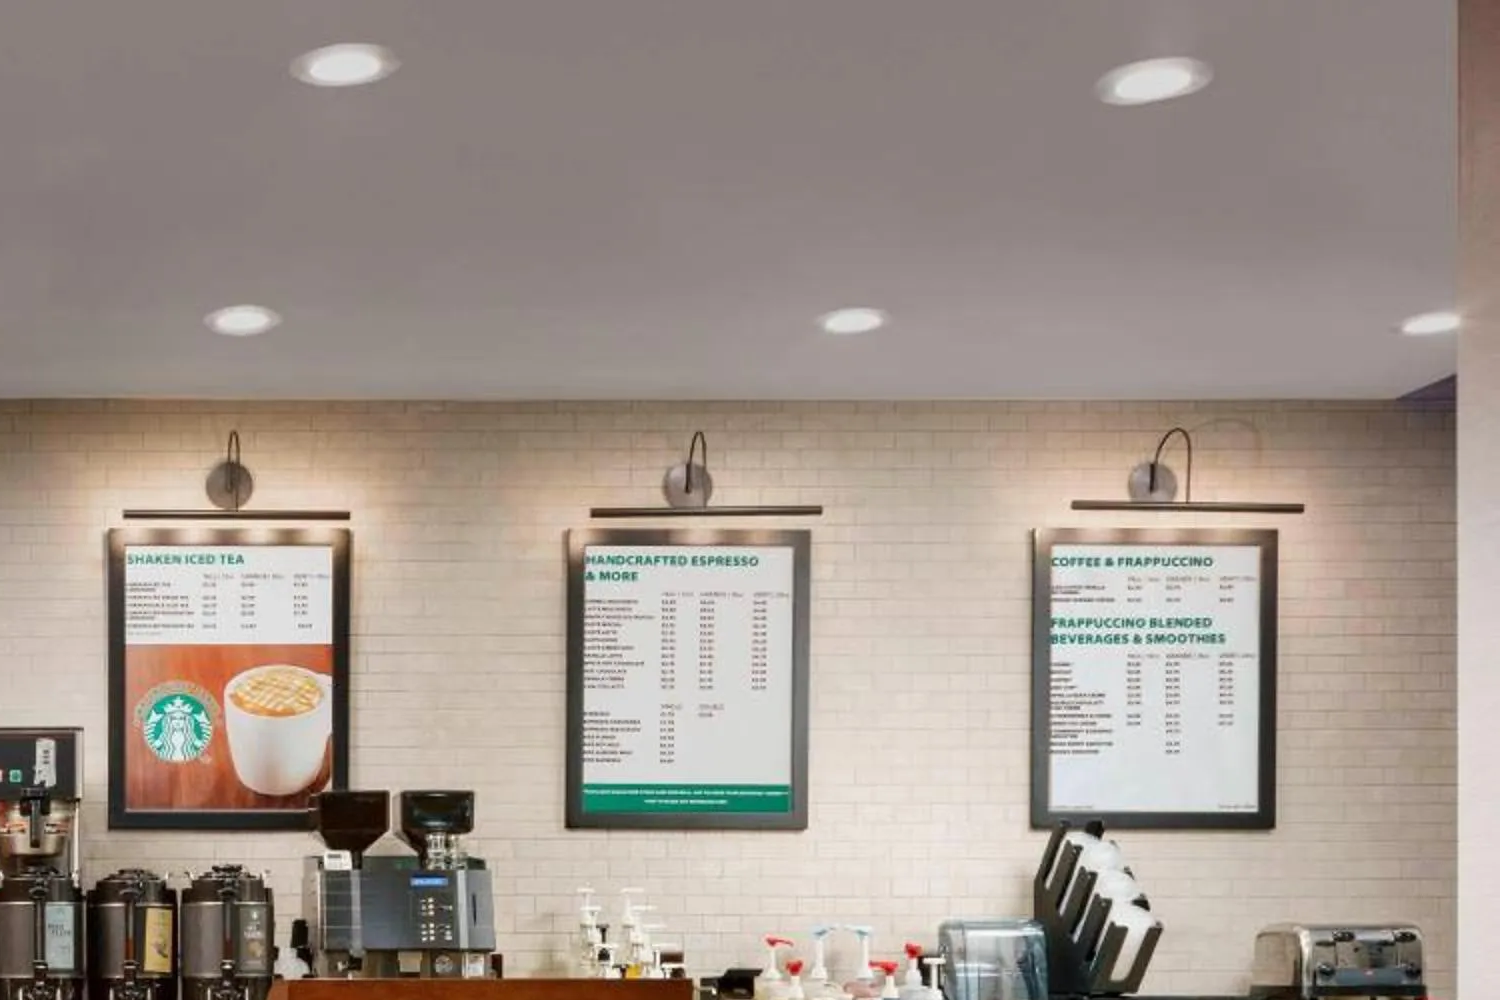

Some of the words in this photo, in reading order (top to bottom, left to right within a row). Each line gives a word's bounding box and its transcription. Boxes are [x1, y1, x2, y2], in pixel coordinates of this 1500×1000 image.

[127, 554, 182, 565] SHAKEN
[184, 554, 215, 565] ICED
[220, 553, 245, 565] TEA
[585, 555, 688, 566] HANDCRAFTED
[691, 556, 759, 567] ESPRESSO
[1051, 557, 1100, 567] COFFEE
[1104, 557, 1114, 567] &
[1118, 557, 1214, 567] FRAPPUCCINO
[585, 571, 595, 581] &
[600, 571, 639, 582] MORE
[1051, 618, 1146, 629] FRAPPUCCINO
[1149, 618, 1213, 628] BLENDED
[1051, 634, 1129, 645] BEVERAGES
[1133, 634, 1142, 645] &
[1145, 634, 1227, 645] SMOOTHIES
